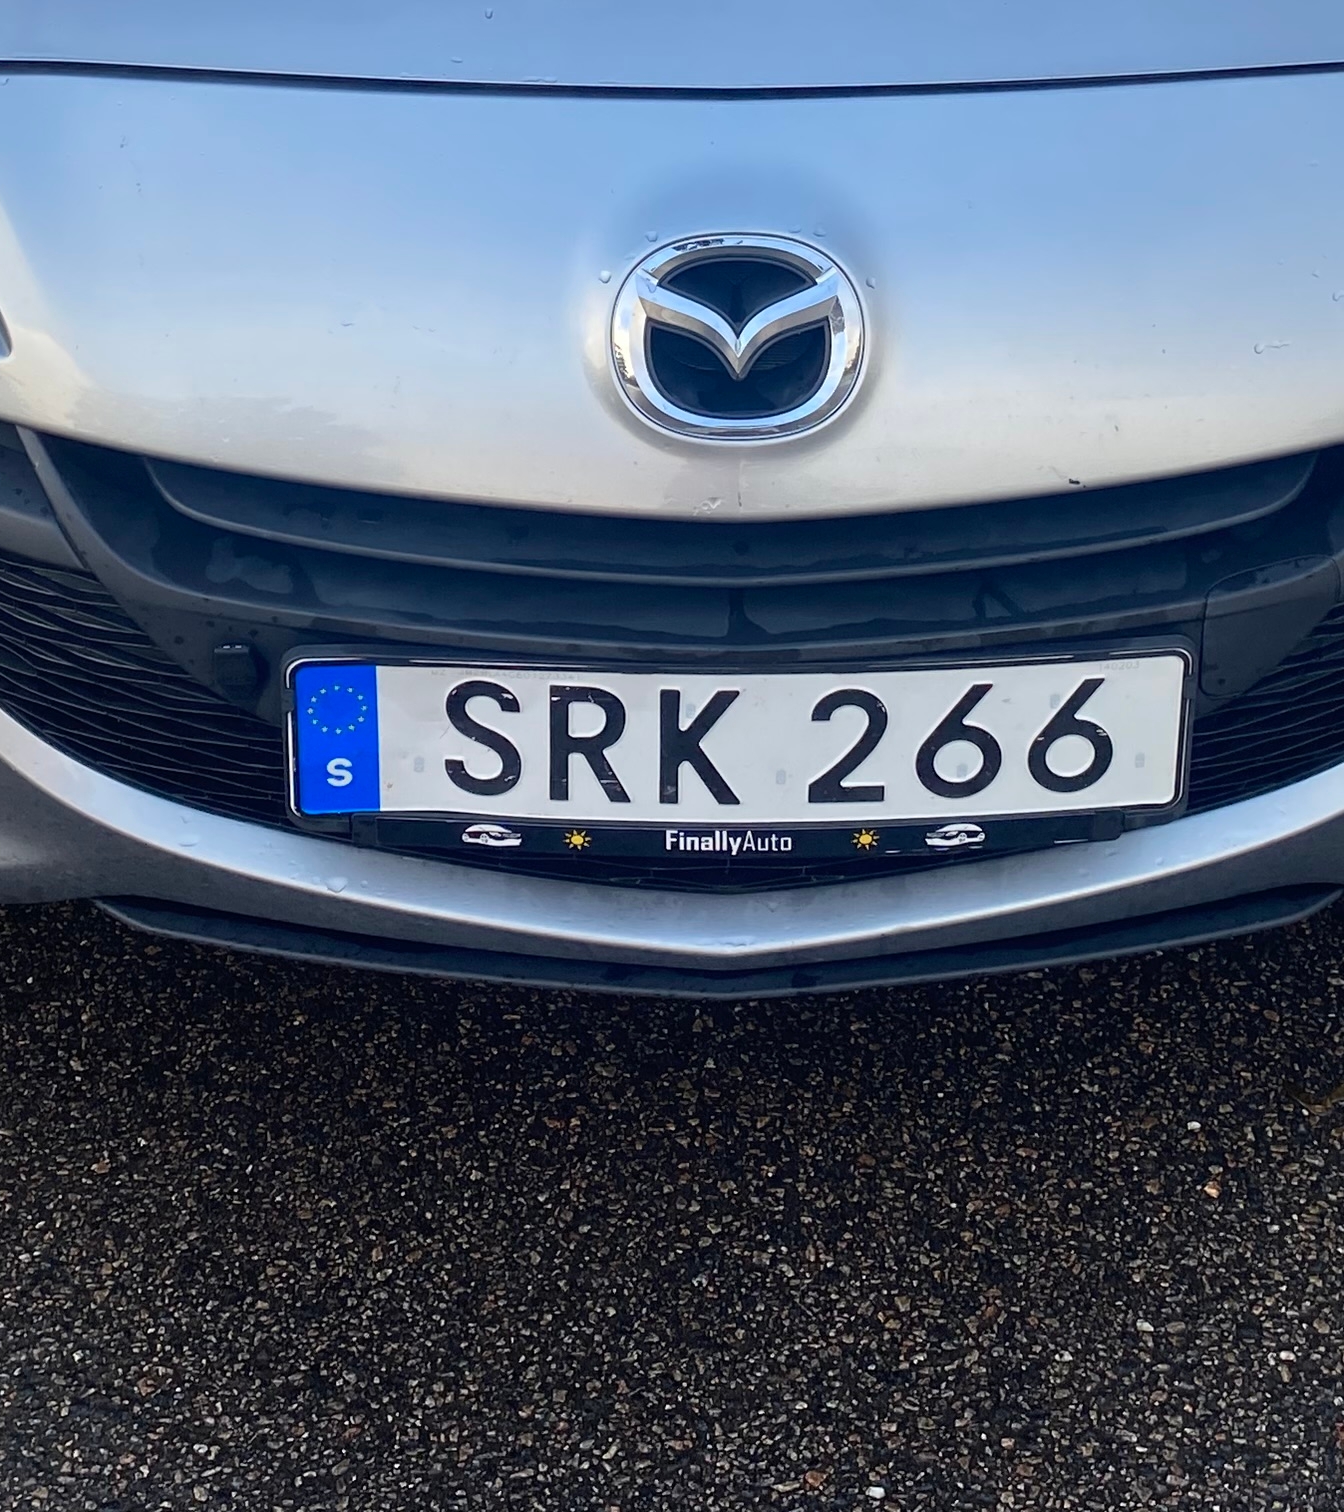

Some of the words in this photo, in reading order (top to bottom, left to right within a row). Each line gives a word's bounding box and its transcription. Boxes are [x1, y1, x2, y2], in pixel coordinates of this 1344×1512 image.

[444, 680, 741, 806] SRK
[807, 677, 1114, 804] 266
[326, 757, 353, 787] S
[664, 829, 792, 855] FinallyAuto
